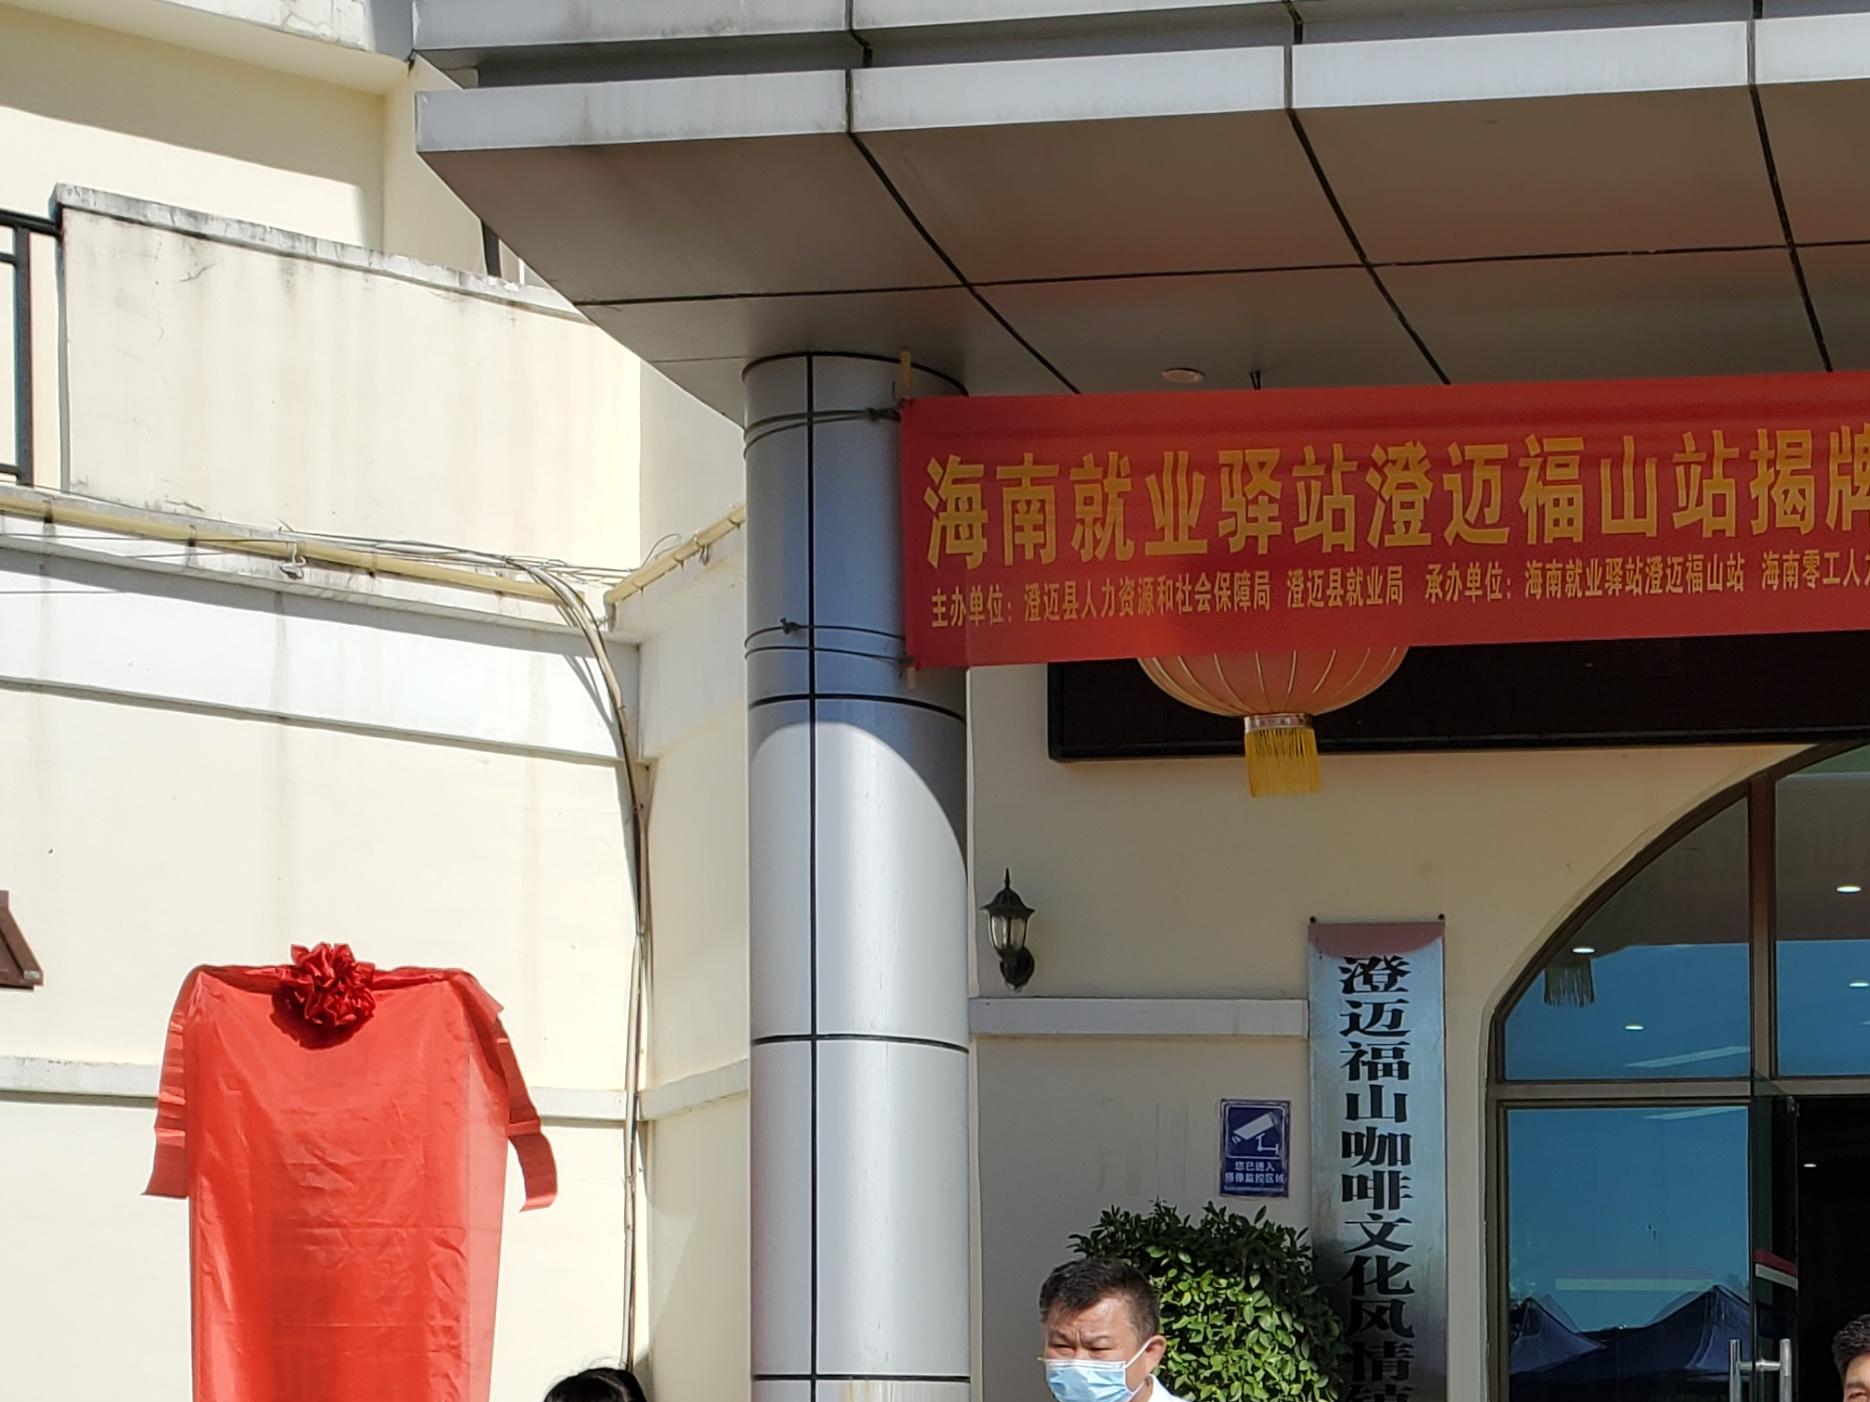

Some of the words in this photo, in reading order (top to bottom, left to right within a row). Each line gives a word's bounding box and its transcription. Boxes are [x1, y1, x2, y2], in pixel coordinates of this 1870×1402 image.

[1286, 565, 1404, 608] 澄迈县就业局
